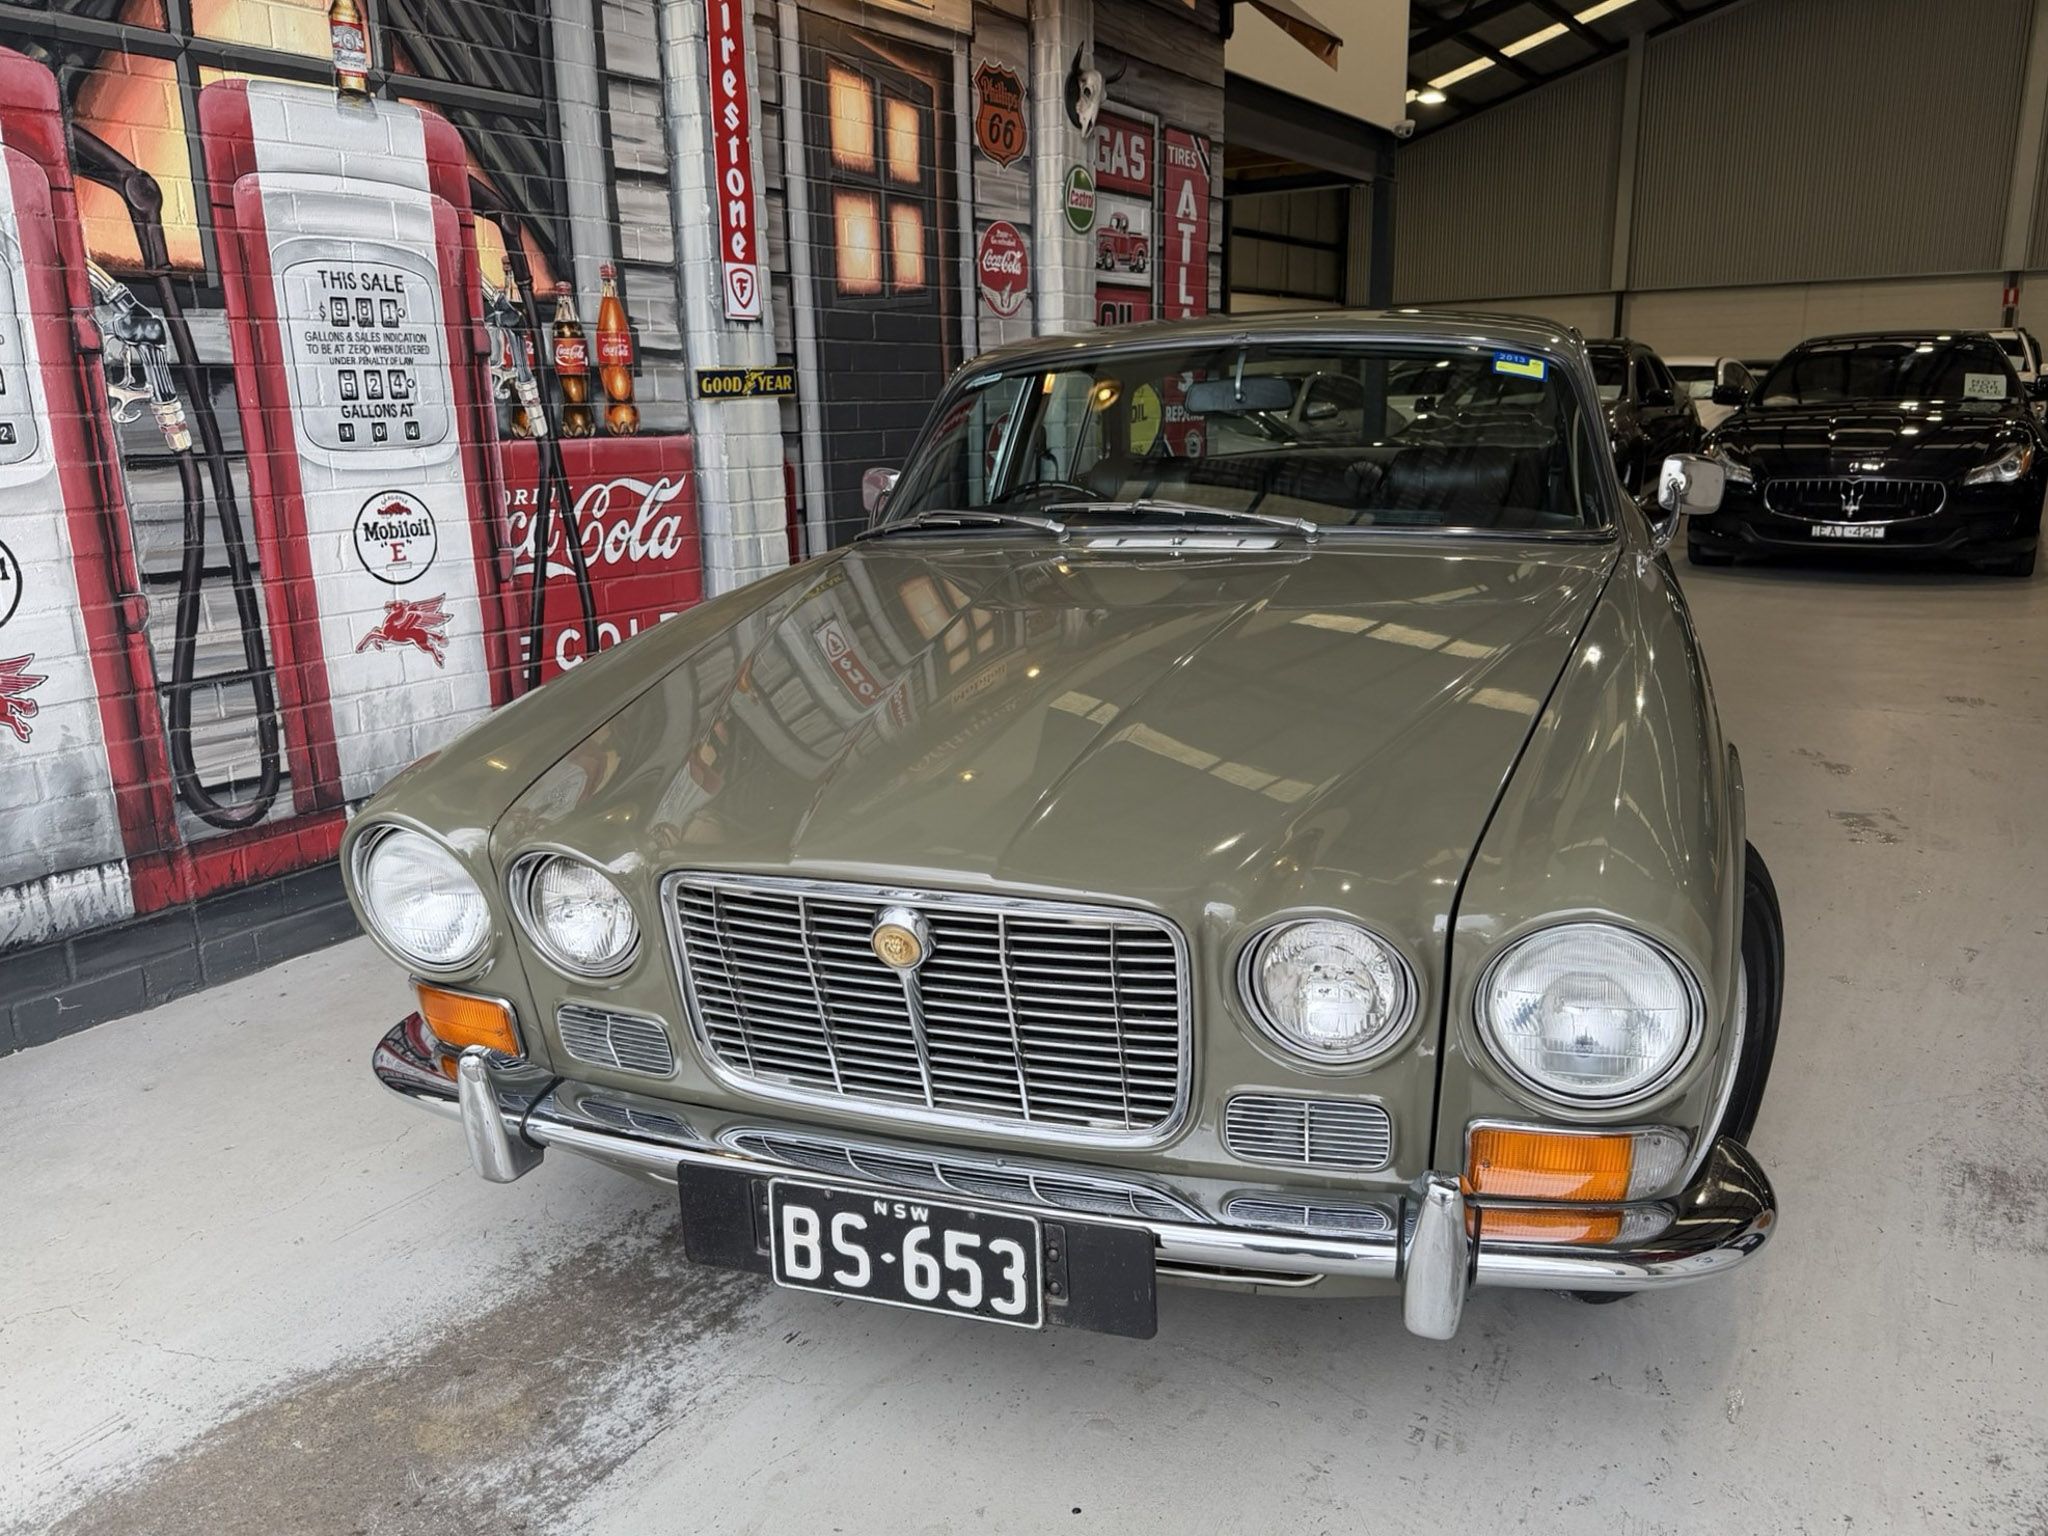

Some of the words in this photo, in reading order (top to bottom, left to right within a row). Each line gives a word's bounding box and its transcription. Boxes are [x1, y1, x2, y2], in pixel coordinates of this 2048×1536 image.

[720, 0, 747, 260] irestone
[989, 113, 1016, 149] 66
[1095, 125, 1145, 180] GAS
[1167, 145, 1197, 168] TIRES
[1070, 189, 1094, 209] Castrol
[317, 270, 356, 290] THIS
[361, 273, 405, 293] SALE
[304, 331, 344, 343] GALLONS
[355, 332, 381, 343] SALES
[382, 333, 427, 343] INDICATION
[306, 343, 320, 355] TO
[321, 344, 333, 355] BE
[334, 344, 346, 355] AT
[348, 345, 371, 355] ZERO
[372, 344, 394, 355] WHEN
[395, 345, 430, 355] DELIVERED
[1499, 353, 1526, 364] 2013
[329, 357, 356, 366] UNDER
[358, 357, 388, 366] PENALTY
[389, 357, 399, 365] OF
[399, 357, 414, 365] LAW
[701, 377, 743, 394] GOOD
[757, 374, 792, 391] YEAR
[341, 403, 398, 419] GALLONS
[400, 402, 415, 418] AT
[363, 519, 431, 542] Mobiloil
[873, 1200, 930, 1224] NSW
